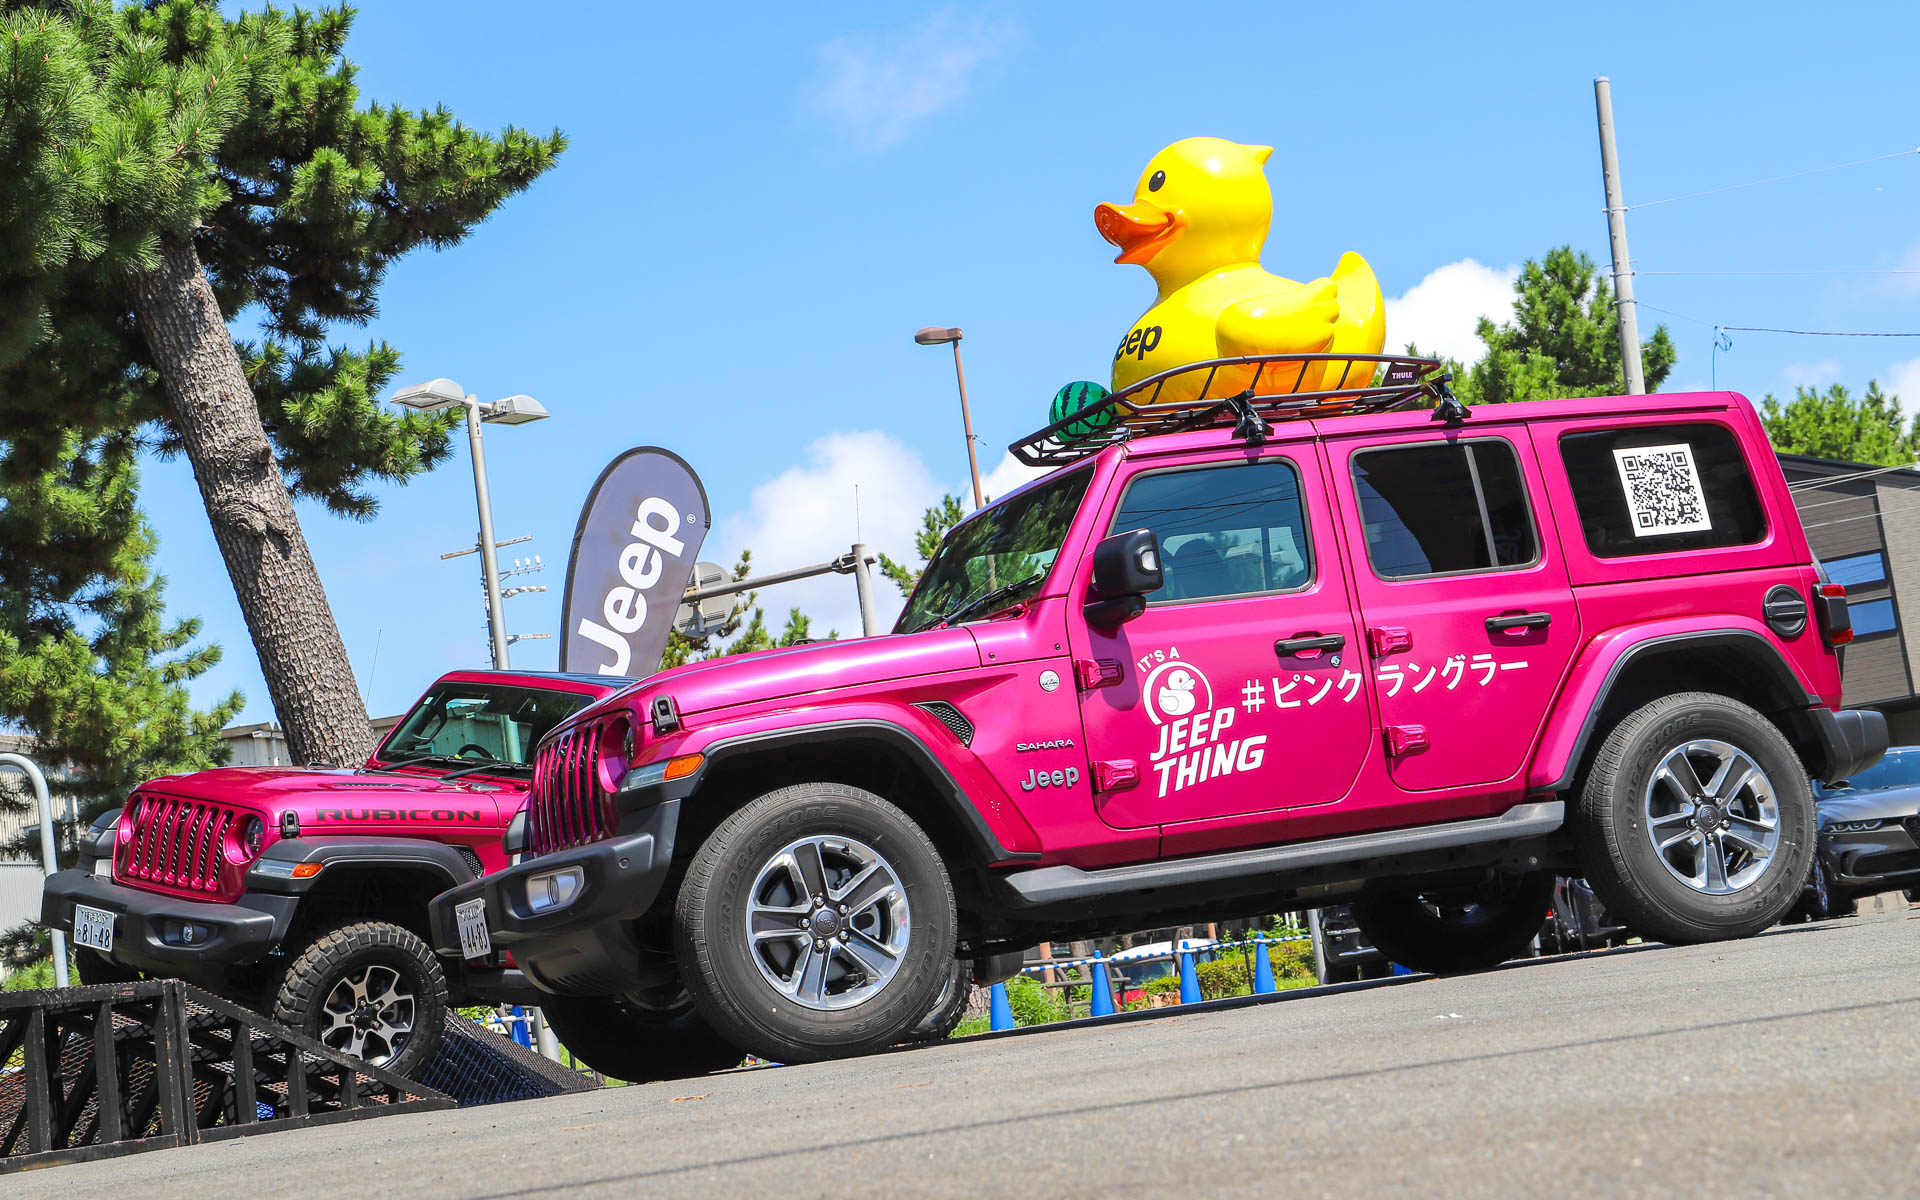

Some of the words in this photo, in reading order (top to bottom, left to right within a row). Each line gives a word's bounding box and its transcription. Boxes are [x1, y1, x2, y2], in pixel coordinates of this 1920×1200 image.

[1391, 371, 1413, 380] THULE
[578, 497, 685, 677] Jeep
[1137, 649, 1165, 673] IT'S
[1169, 646, 1180, 659] A
[1016, 738, 1075, 754] SAHARA
[1150, 706, 1236, 762] JEEP
[1020, 766, 1080, 791] Jeep
[1153, 735, 1267, 798] THING
[316, 809, 481, 821] RUBICON
[82, 923, 110, 948] 81-48
